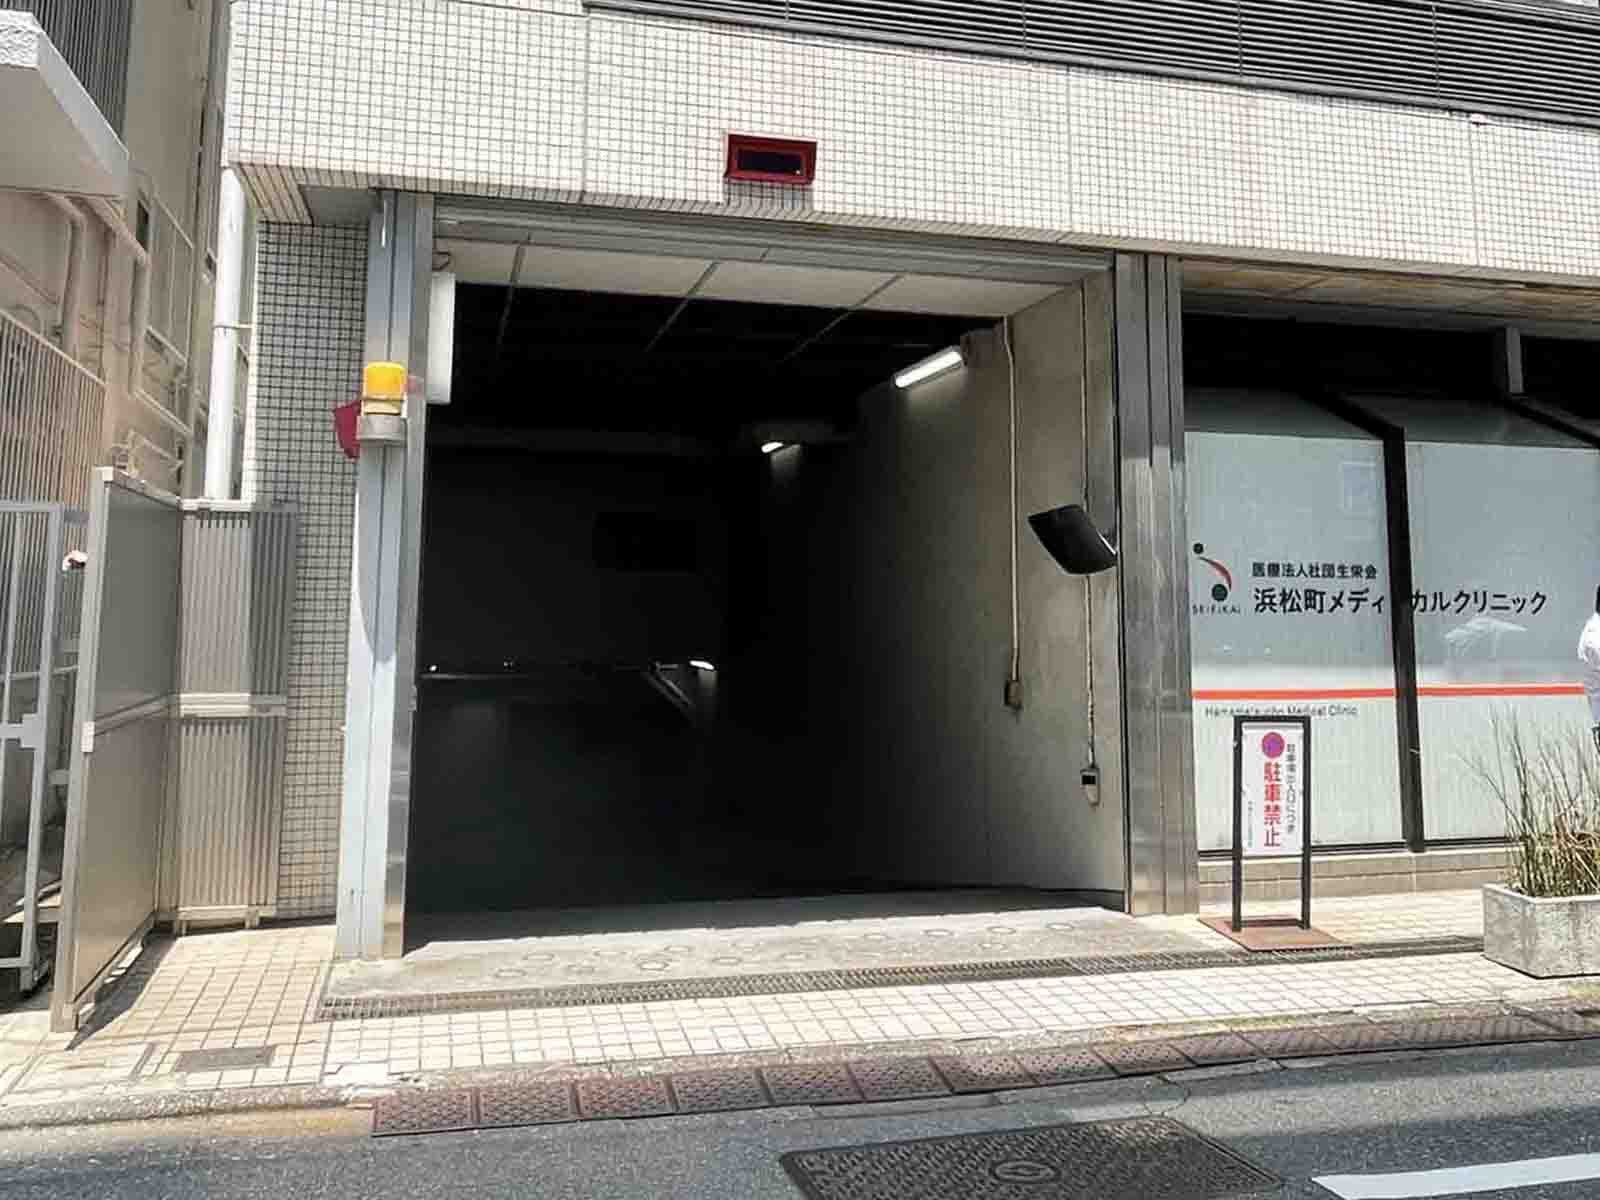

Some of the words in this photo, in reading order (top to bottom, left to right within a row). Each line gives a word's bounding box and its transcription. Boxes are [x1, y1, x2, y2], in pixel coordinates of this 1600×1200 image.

[1252, 562, 1377, 580] 医療法人社団生栄会
[1263, 761, 1282, 848] 駐車禁止
